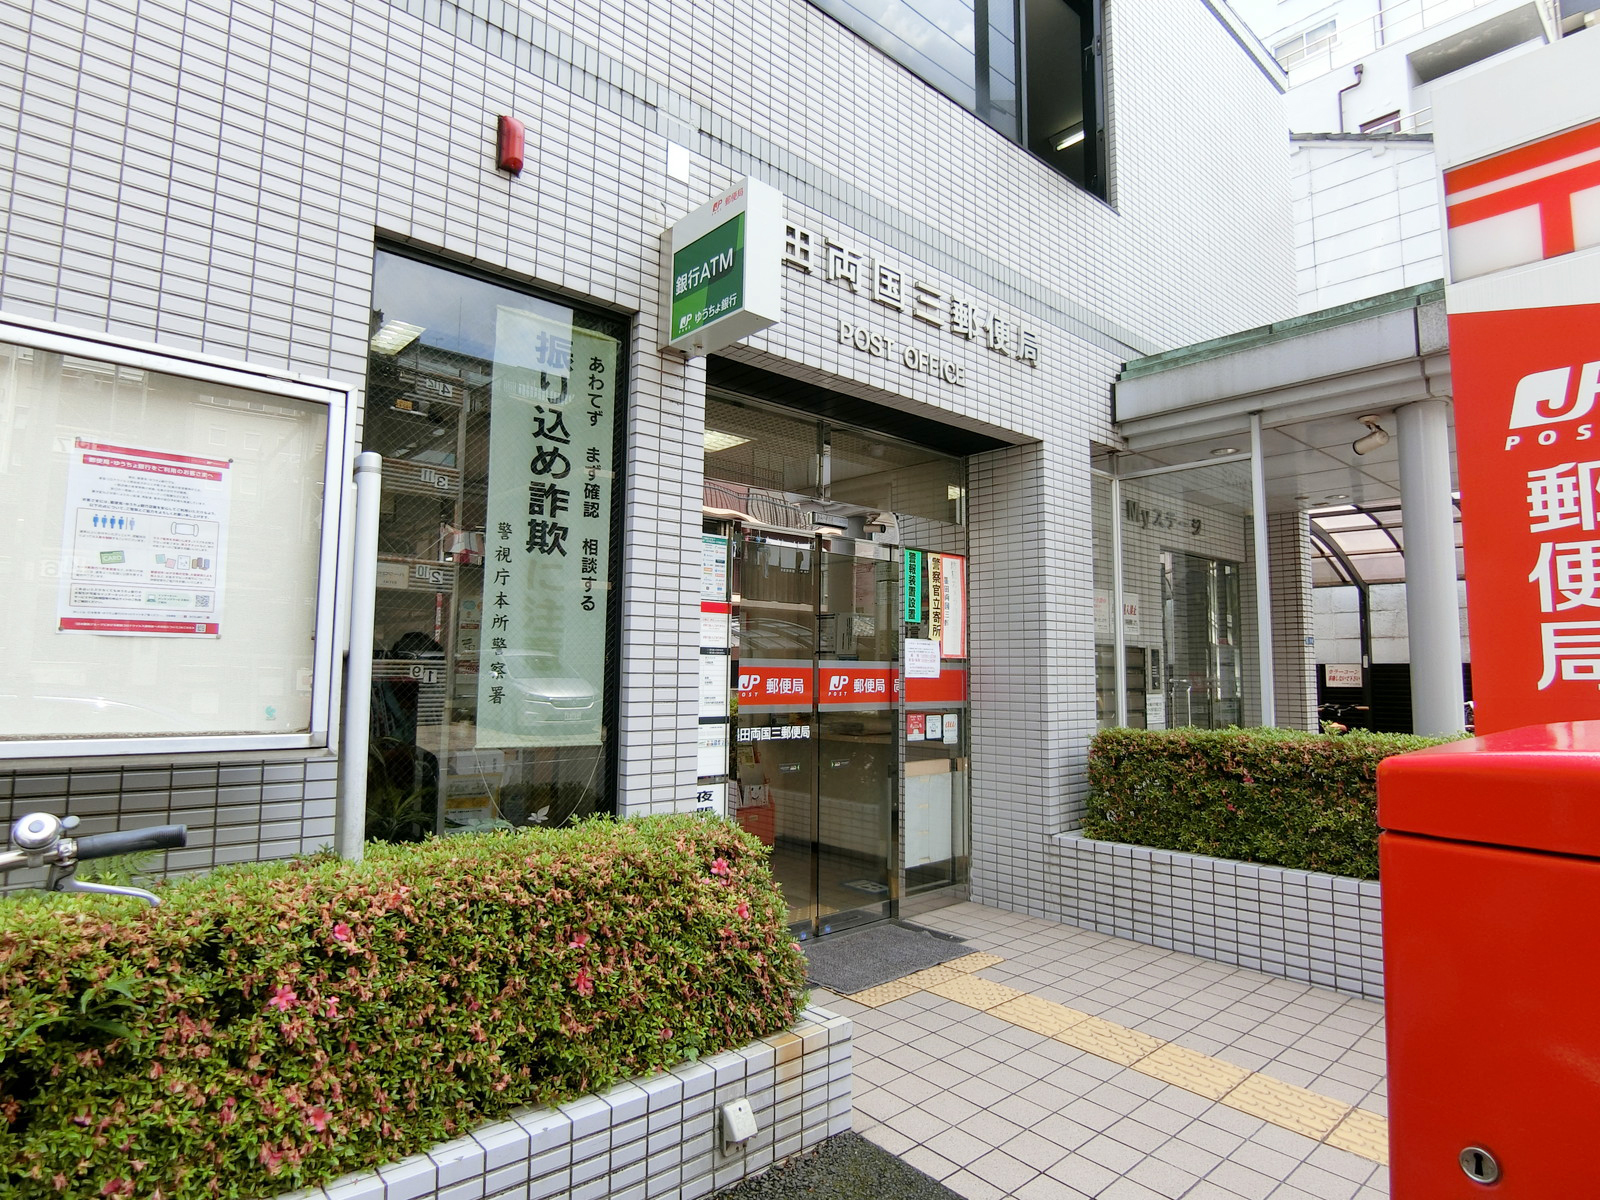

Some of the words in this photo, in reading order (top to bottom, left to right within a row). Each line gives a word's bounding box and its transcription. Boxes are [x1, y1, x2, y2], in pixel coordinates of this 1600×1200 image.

[675, 247, 734, 297] 銀行ATM
[782, 223, 1042, 369] 田両国三郵便局
[679, 313, 692, 330] JP
[694, 292, 738, 324] ゆうちょ銀行
[838, 319, 895, 362] POST
[903, 345, 966, 388] OFFICE
[587, 355, 605, 427] あわてず
[583, 446, 602, 519] まず確認
[580, 537, 599, 612] 相談する
[931, 557, 941, 637] 警察官立寄所
[488, 521, 513, 705] 警視庁本所警察署
[738, 674, 761, 692] JP
[766, 678, 804, 694] 郵便局
[829, 675, 849, 691] JP
[853, 678, 886, 693] 郵便局
[736, 725, 811, 742] 田両国三郵便局
